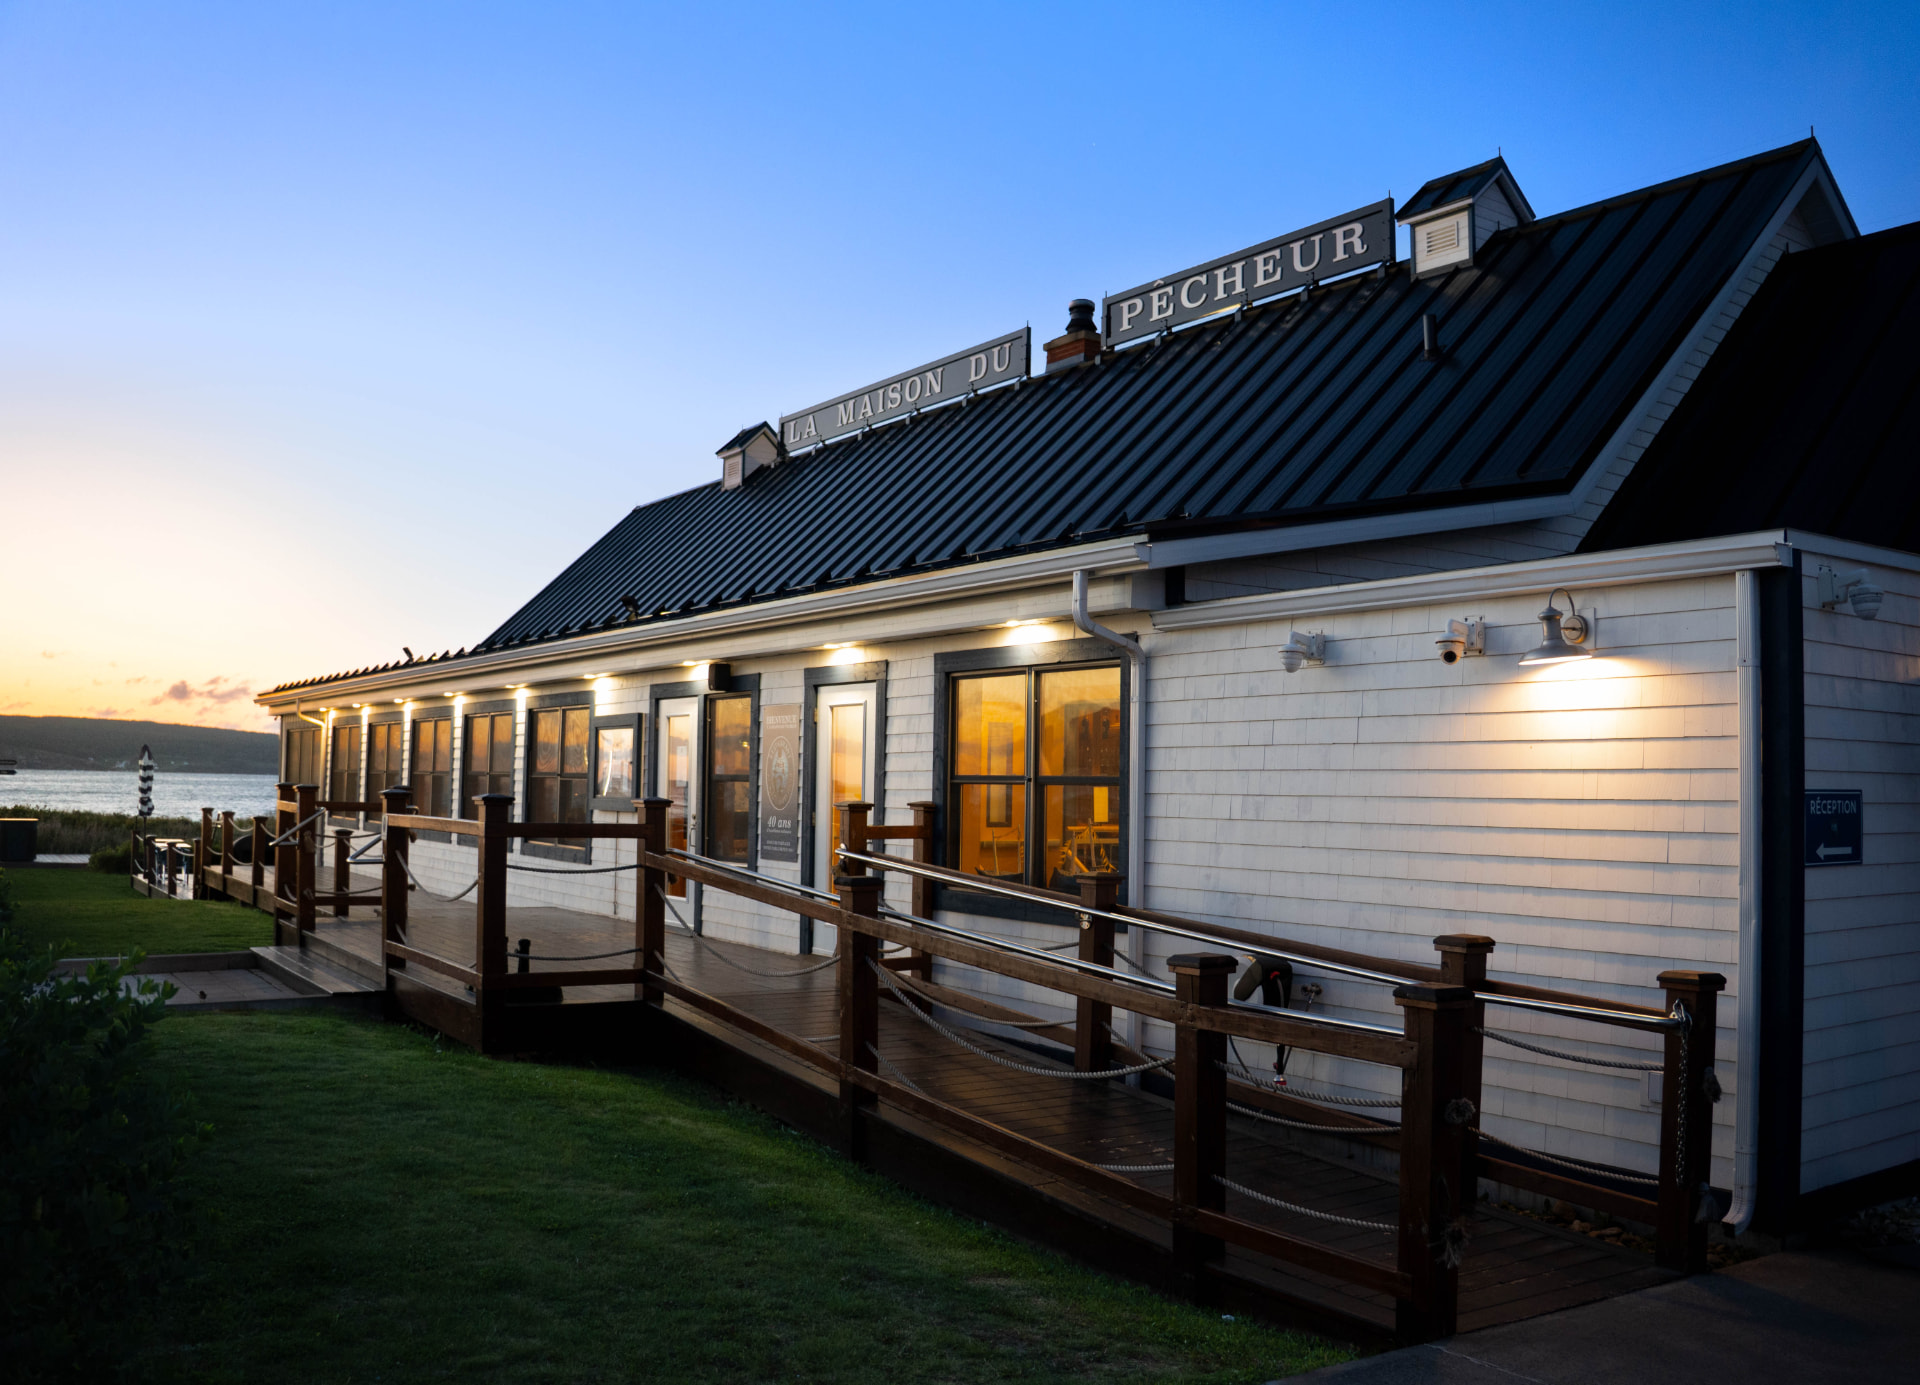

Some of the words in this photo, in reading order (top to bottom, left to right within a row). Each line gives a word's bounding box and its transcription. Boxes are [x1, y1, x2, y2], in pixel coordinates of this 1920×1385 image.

[1119, 222, 1368, 332] PÊCHEUR
[788, 414, 818, 444] LA
[836, 367, 945, 427] MAISON
[968, 343, 1013, 382] DU
[767, 815, 777, 828] 40
[777, 819, 792, 829] ans
[1810, 797, 1856, 814] RÉCEPTION
